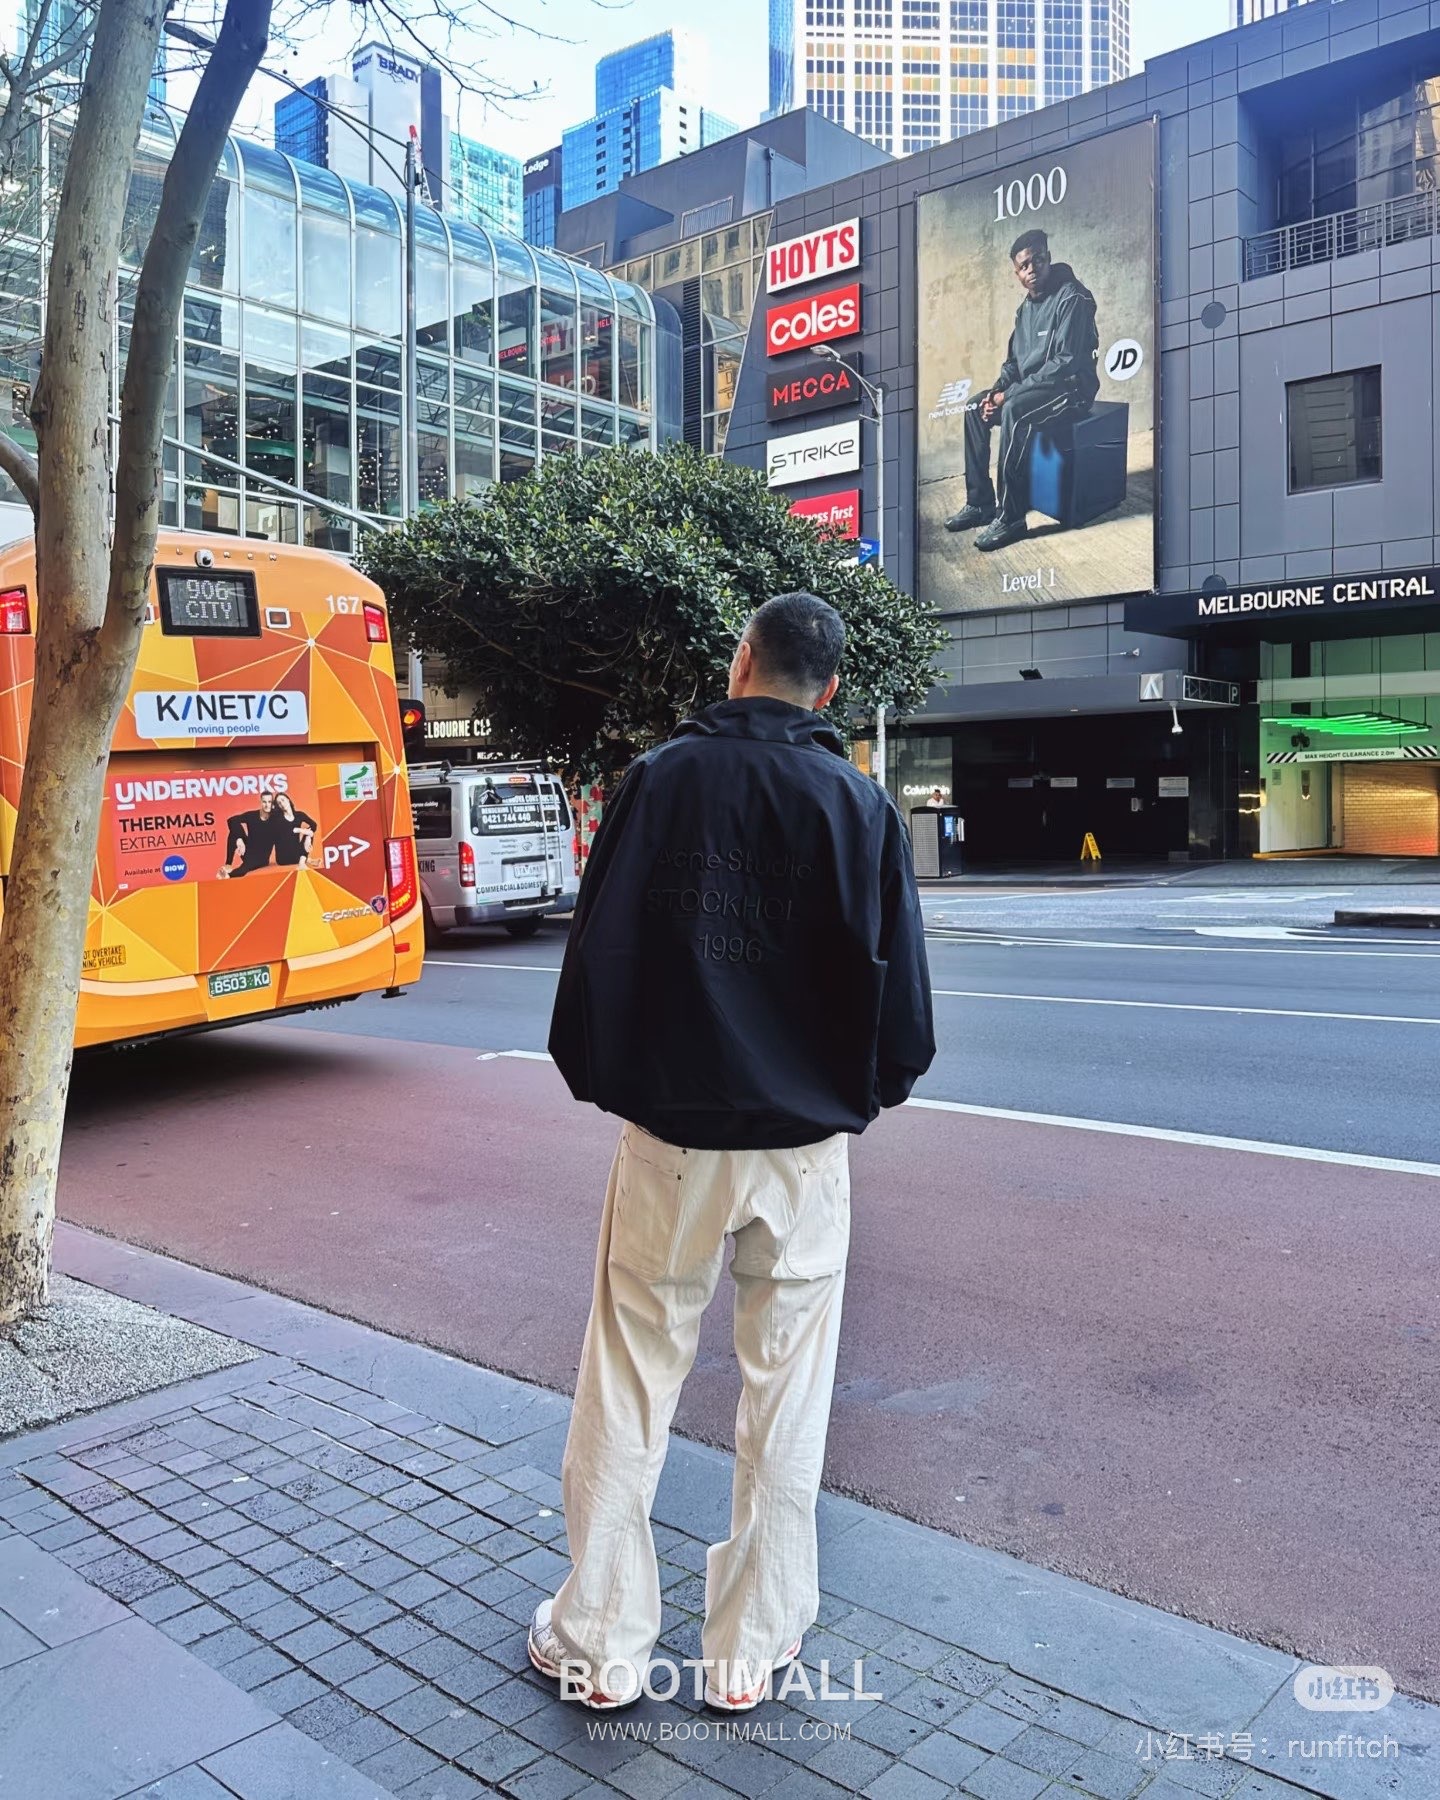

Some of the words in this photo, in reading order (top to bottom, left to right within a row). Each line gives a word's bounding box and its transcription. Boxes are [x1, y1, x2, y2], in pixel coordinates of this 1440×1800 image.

[380, 57, 421, 83] BRADY
[993, 166, 1067, 222] 1000
[770, 226, 855, 286] HOYTS
[770, 299, 856, 346] coles
[1110, 348, 1137, 373] JD
[773, 370, 850, 406] MECCA
[772, 439, 855, 470] STRIKE
[187, 579, 229, 600] 906
[1002, 568, 1042, 592] Level
[1047, 568, 1057, 587] 1
[325, 594, 359, 614] 167
[1198, 586, 1324, 616] MELBOURNE
[1333, 576, 1435, 604] CENTRAL
[185, 600, 232, 619] CITY
[188, 725, 225, 735] moving
[227, 724, 260, 734] people
[1342, 750, 1380, 758] CLEARANCE
[115, 773, 288, 806] UNDERWORKS
[119, 812, 215, 833] THERMALS
[482, 814, 501, 823] 0421
[503, 813, 516, 822] 744
[120, 836, 167, 851] EXTRA
[172, 831, 217, 845] WARM
[656, 848, 721, 871] Acne
[125, 867, 153, 876] Available
[92, 945, 122, 959] OVERTAKE
[697, 932, 762, 962] 1996
[99, 955, 122, 967] VEHICLE
